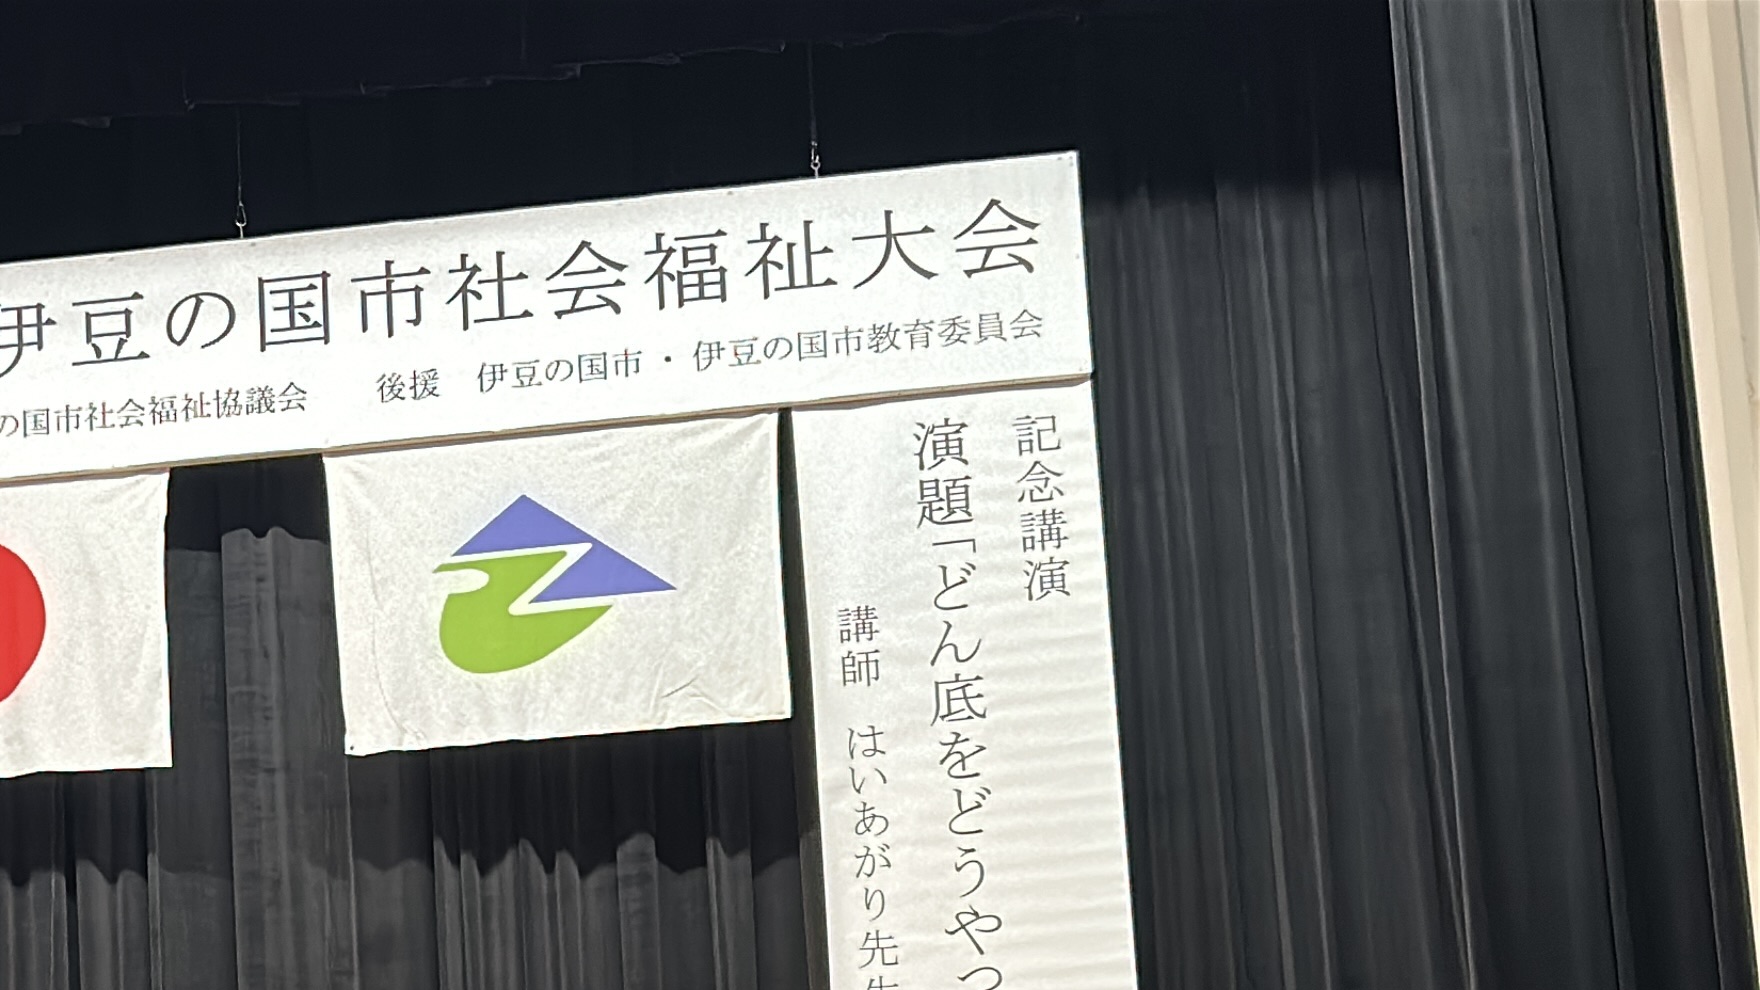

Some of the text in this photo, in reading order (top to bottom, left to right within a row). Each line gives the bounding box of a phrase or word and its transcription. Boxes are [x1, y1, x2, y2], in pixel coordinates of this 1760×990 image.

[375, 367, 440, 404] 後援
[1011, 414, 1071, 602] 記念講演
[837, 604, 880, 687] 講師
